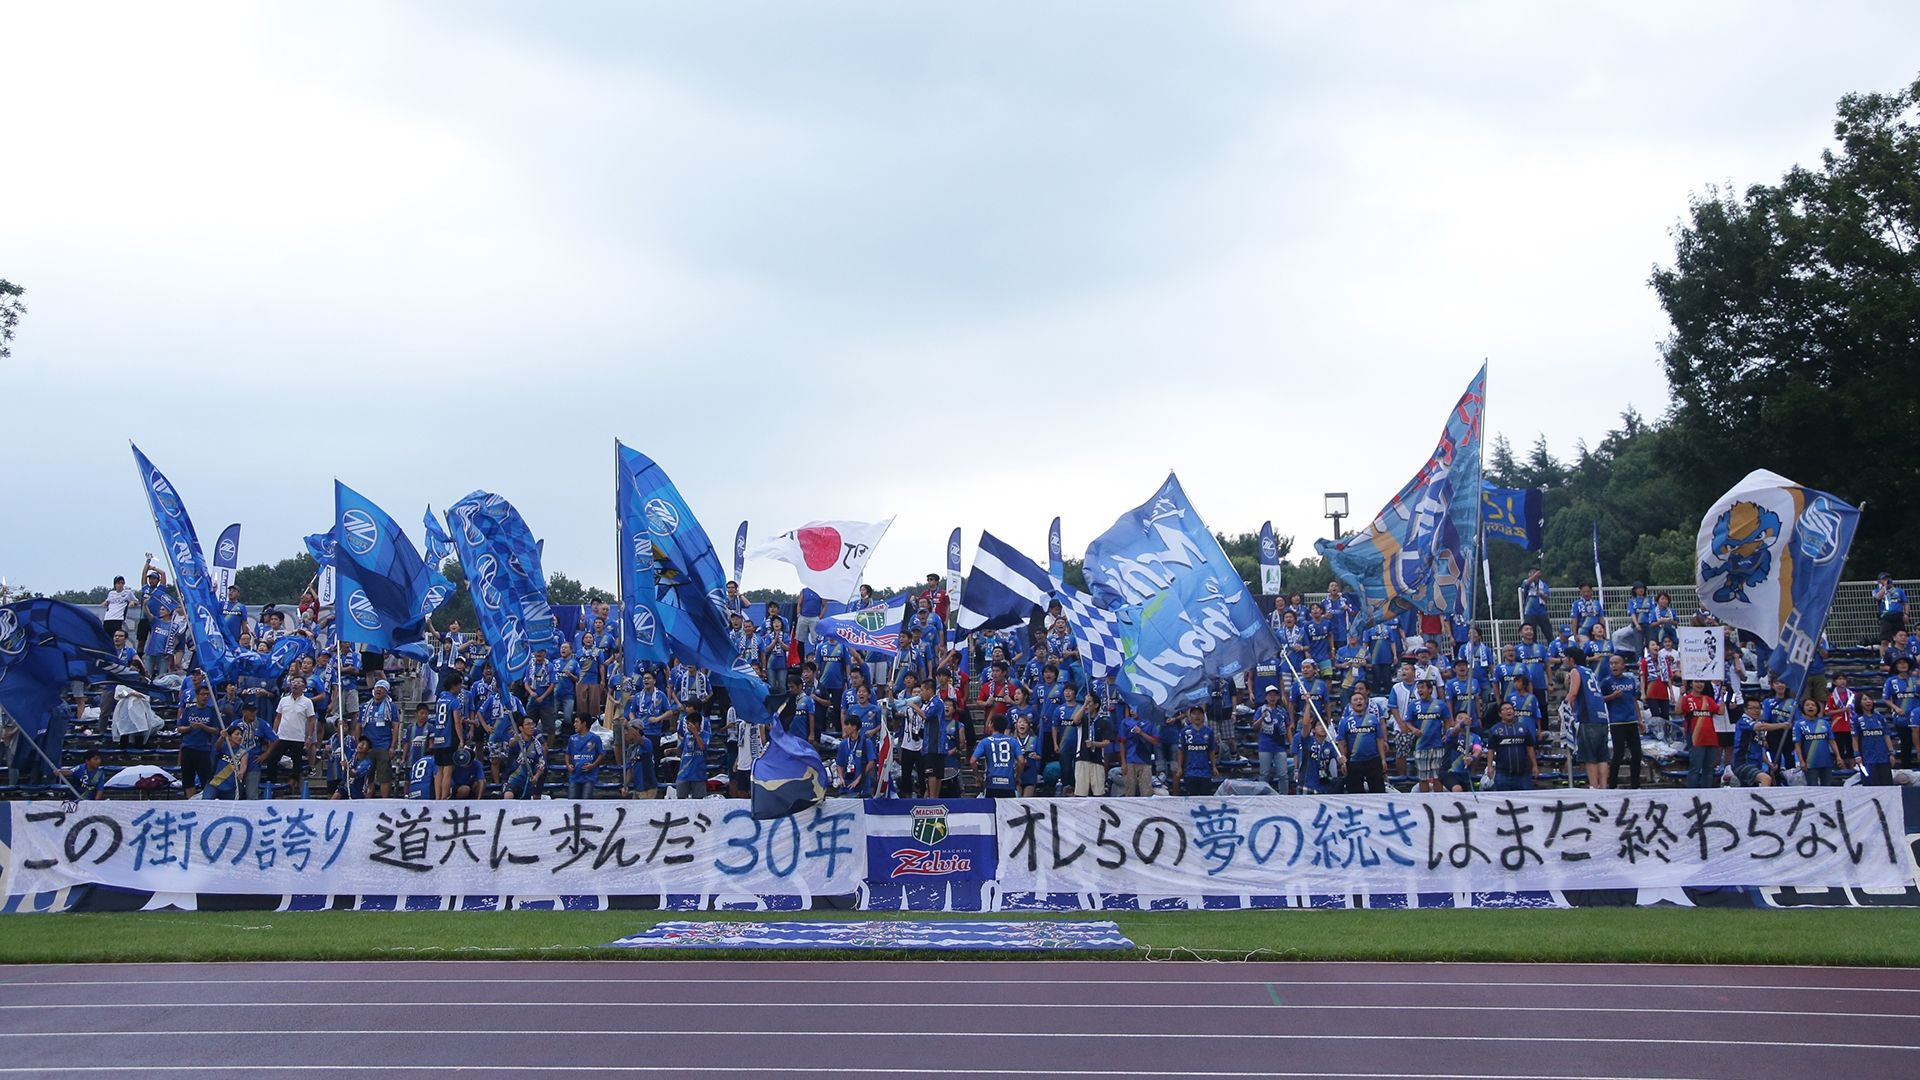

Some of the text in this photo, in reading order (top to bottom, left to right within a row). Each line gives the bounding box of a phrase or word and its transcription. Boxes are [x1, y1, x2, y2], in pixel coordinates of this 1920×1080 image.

[846, 694, 855, 704] 30
[1415, 704, 1421, 713] 9
[1347, 719, 1357, 729] 12
[1184, 734, 1194, 744] 12
[990, 740, 1011, 763] 18
[411, 759, 428, 780] 18
[24, 806, 354, 872] この街の誇り
[890, 848, 972, 878] Zelvia
